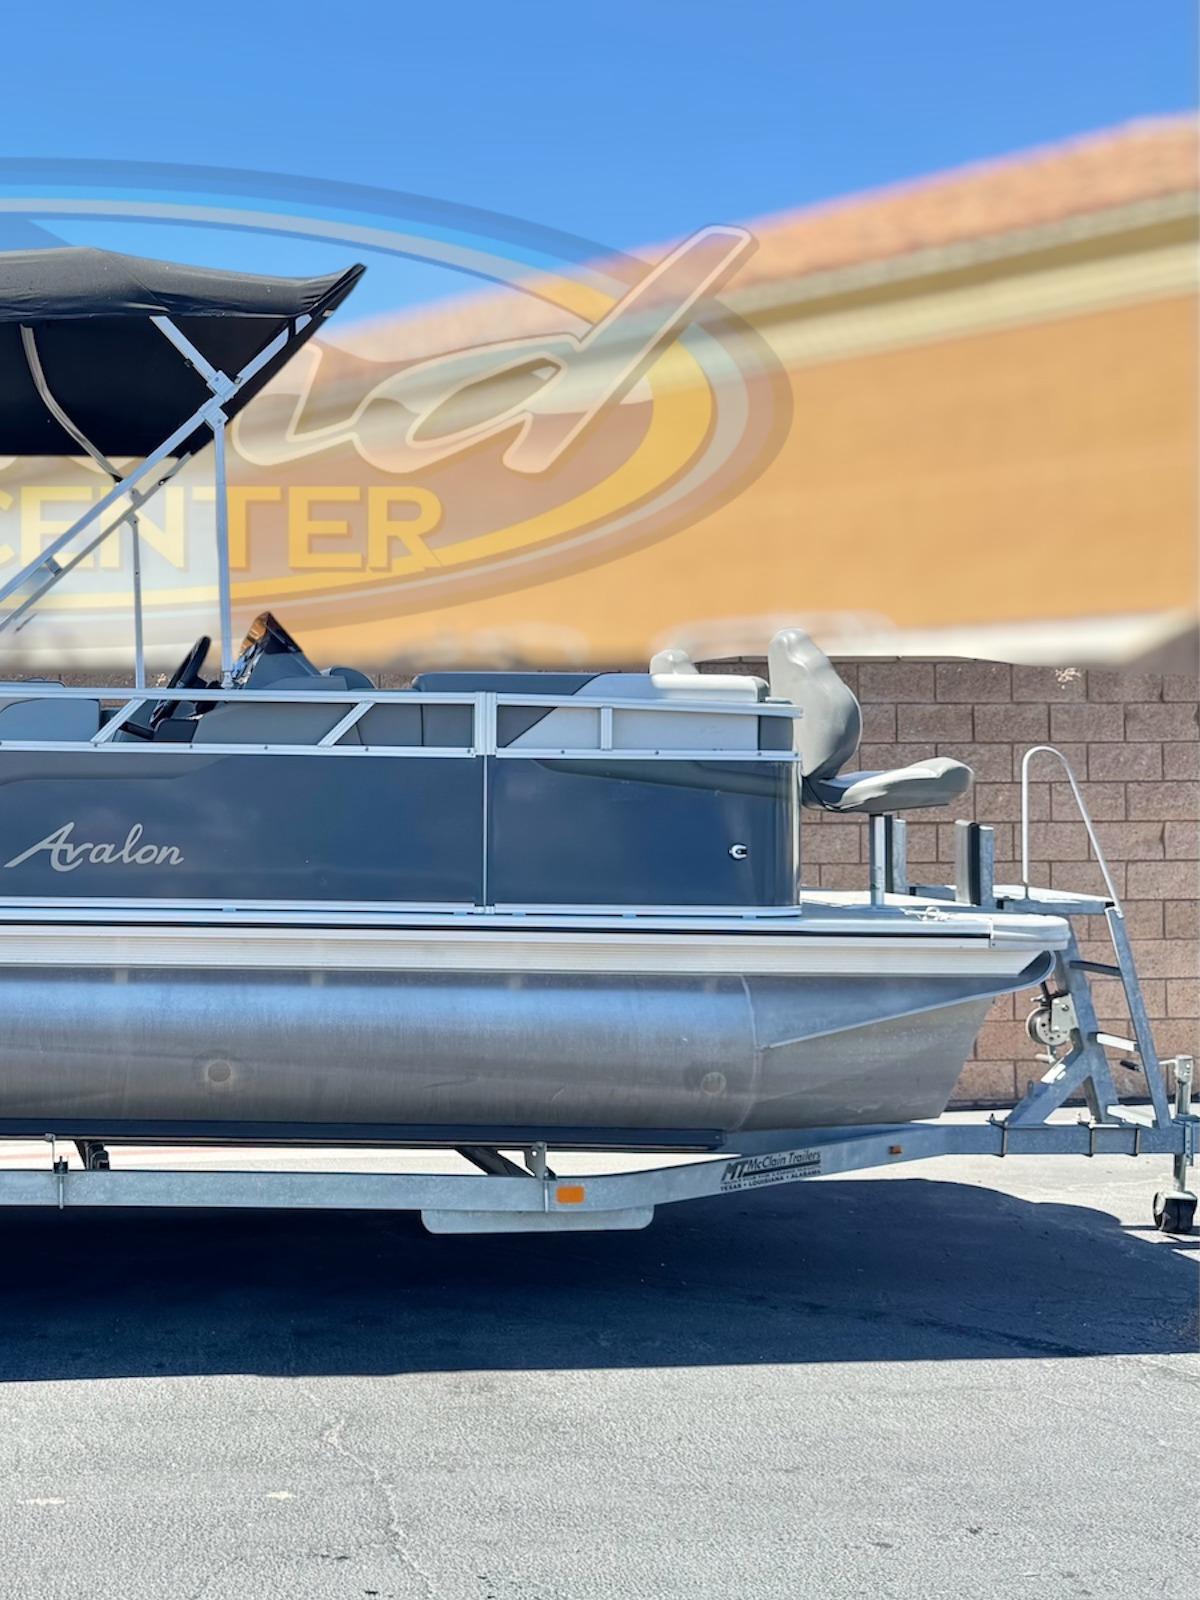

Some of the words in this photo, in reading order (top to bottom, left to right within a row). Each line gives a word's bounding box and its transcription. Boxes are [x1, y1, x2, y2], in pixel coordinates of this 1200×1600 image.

[3, 821, 185, 872] Avalon
[747, 1154, 786, 1171] McClain
[789, 1150, 821, 1164] Trailers
[720, 1183, 742, 1192] TEXAS
[749, 1175, 784, 1187] LOUISIANA
[791, 1169, 821, 1179] ALABAMA
